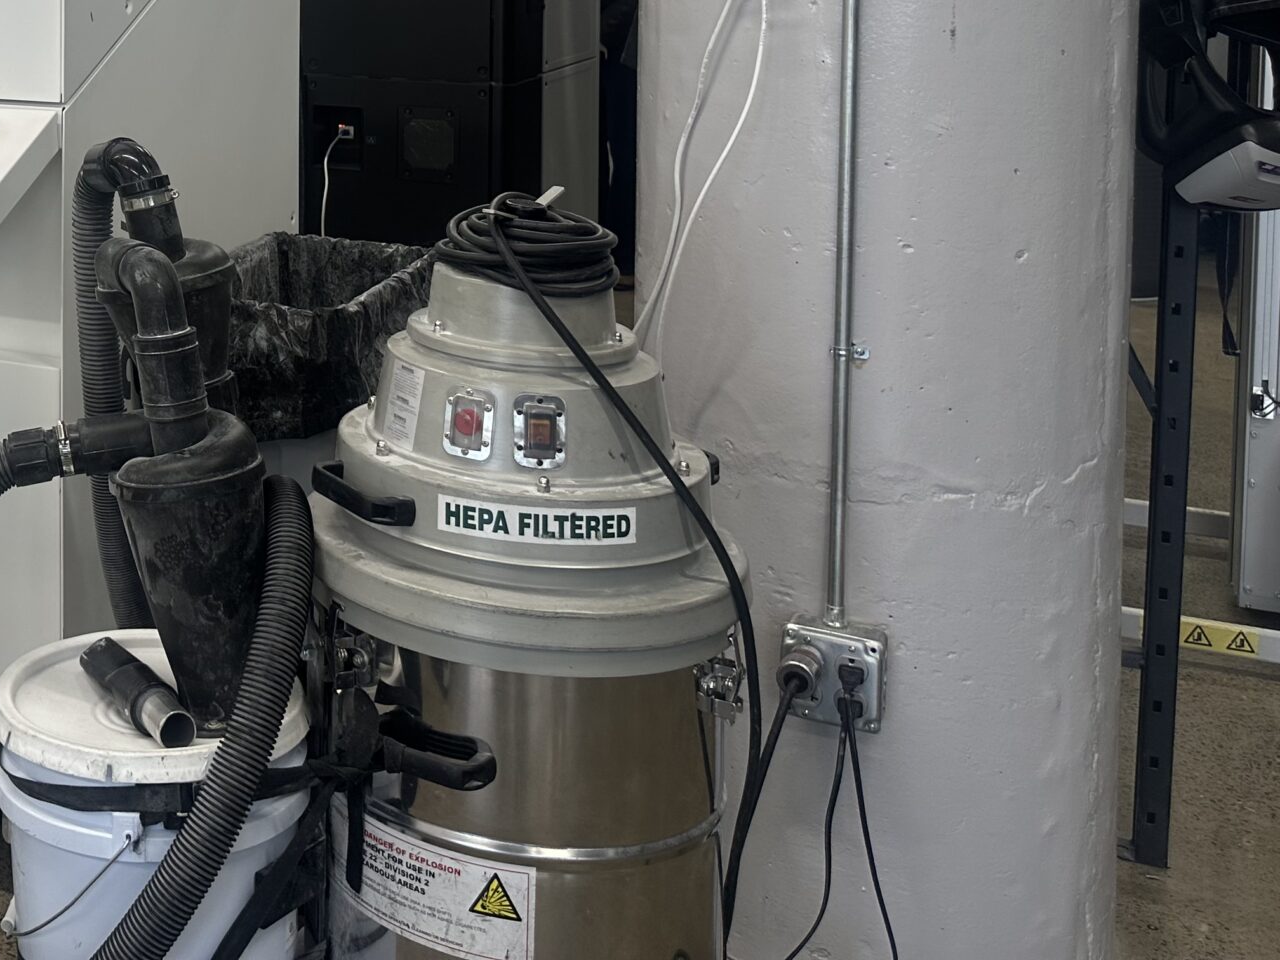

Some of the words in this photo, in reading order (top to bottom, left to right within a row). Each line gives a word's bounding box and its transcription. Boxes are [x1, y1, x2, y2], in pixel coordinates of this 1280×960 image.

[445, 502, 510, 535] HEPA
[518, 512, 631, 541] FILTERED
[363, 829, 394, 851] DANGER
[395, 846, 407, 856] OF
[408, 852, 462, 877] EXPLOSION
[363, 839, 386, 858] MENT
[387, 853, 404, 866] FOR
[405, 861, 423, 875] USE
[425, 869, 436, 879] IN
[369, 853, 378, 862] 22
[384, 862, 422, 883] DIVISION
[424, 879, 430, 887] 2
[363, 859, 396, 882] ZARDOUS
[397, 878, 426, 896] AREAS
